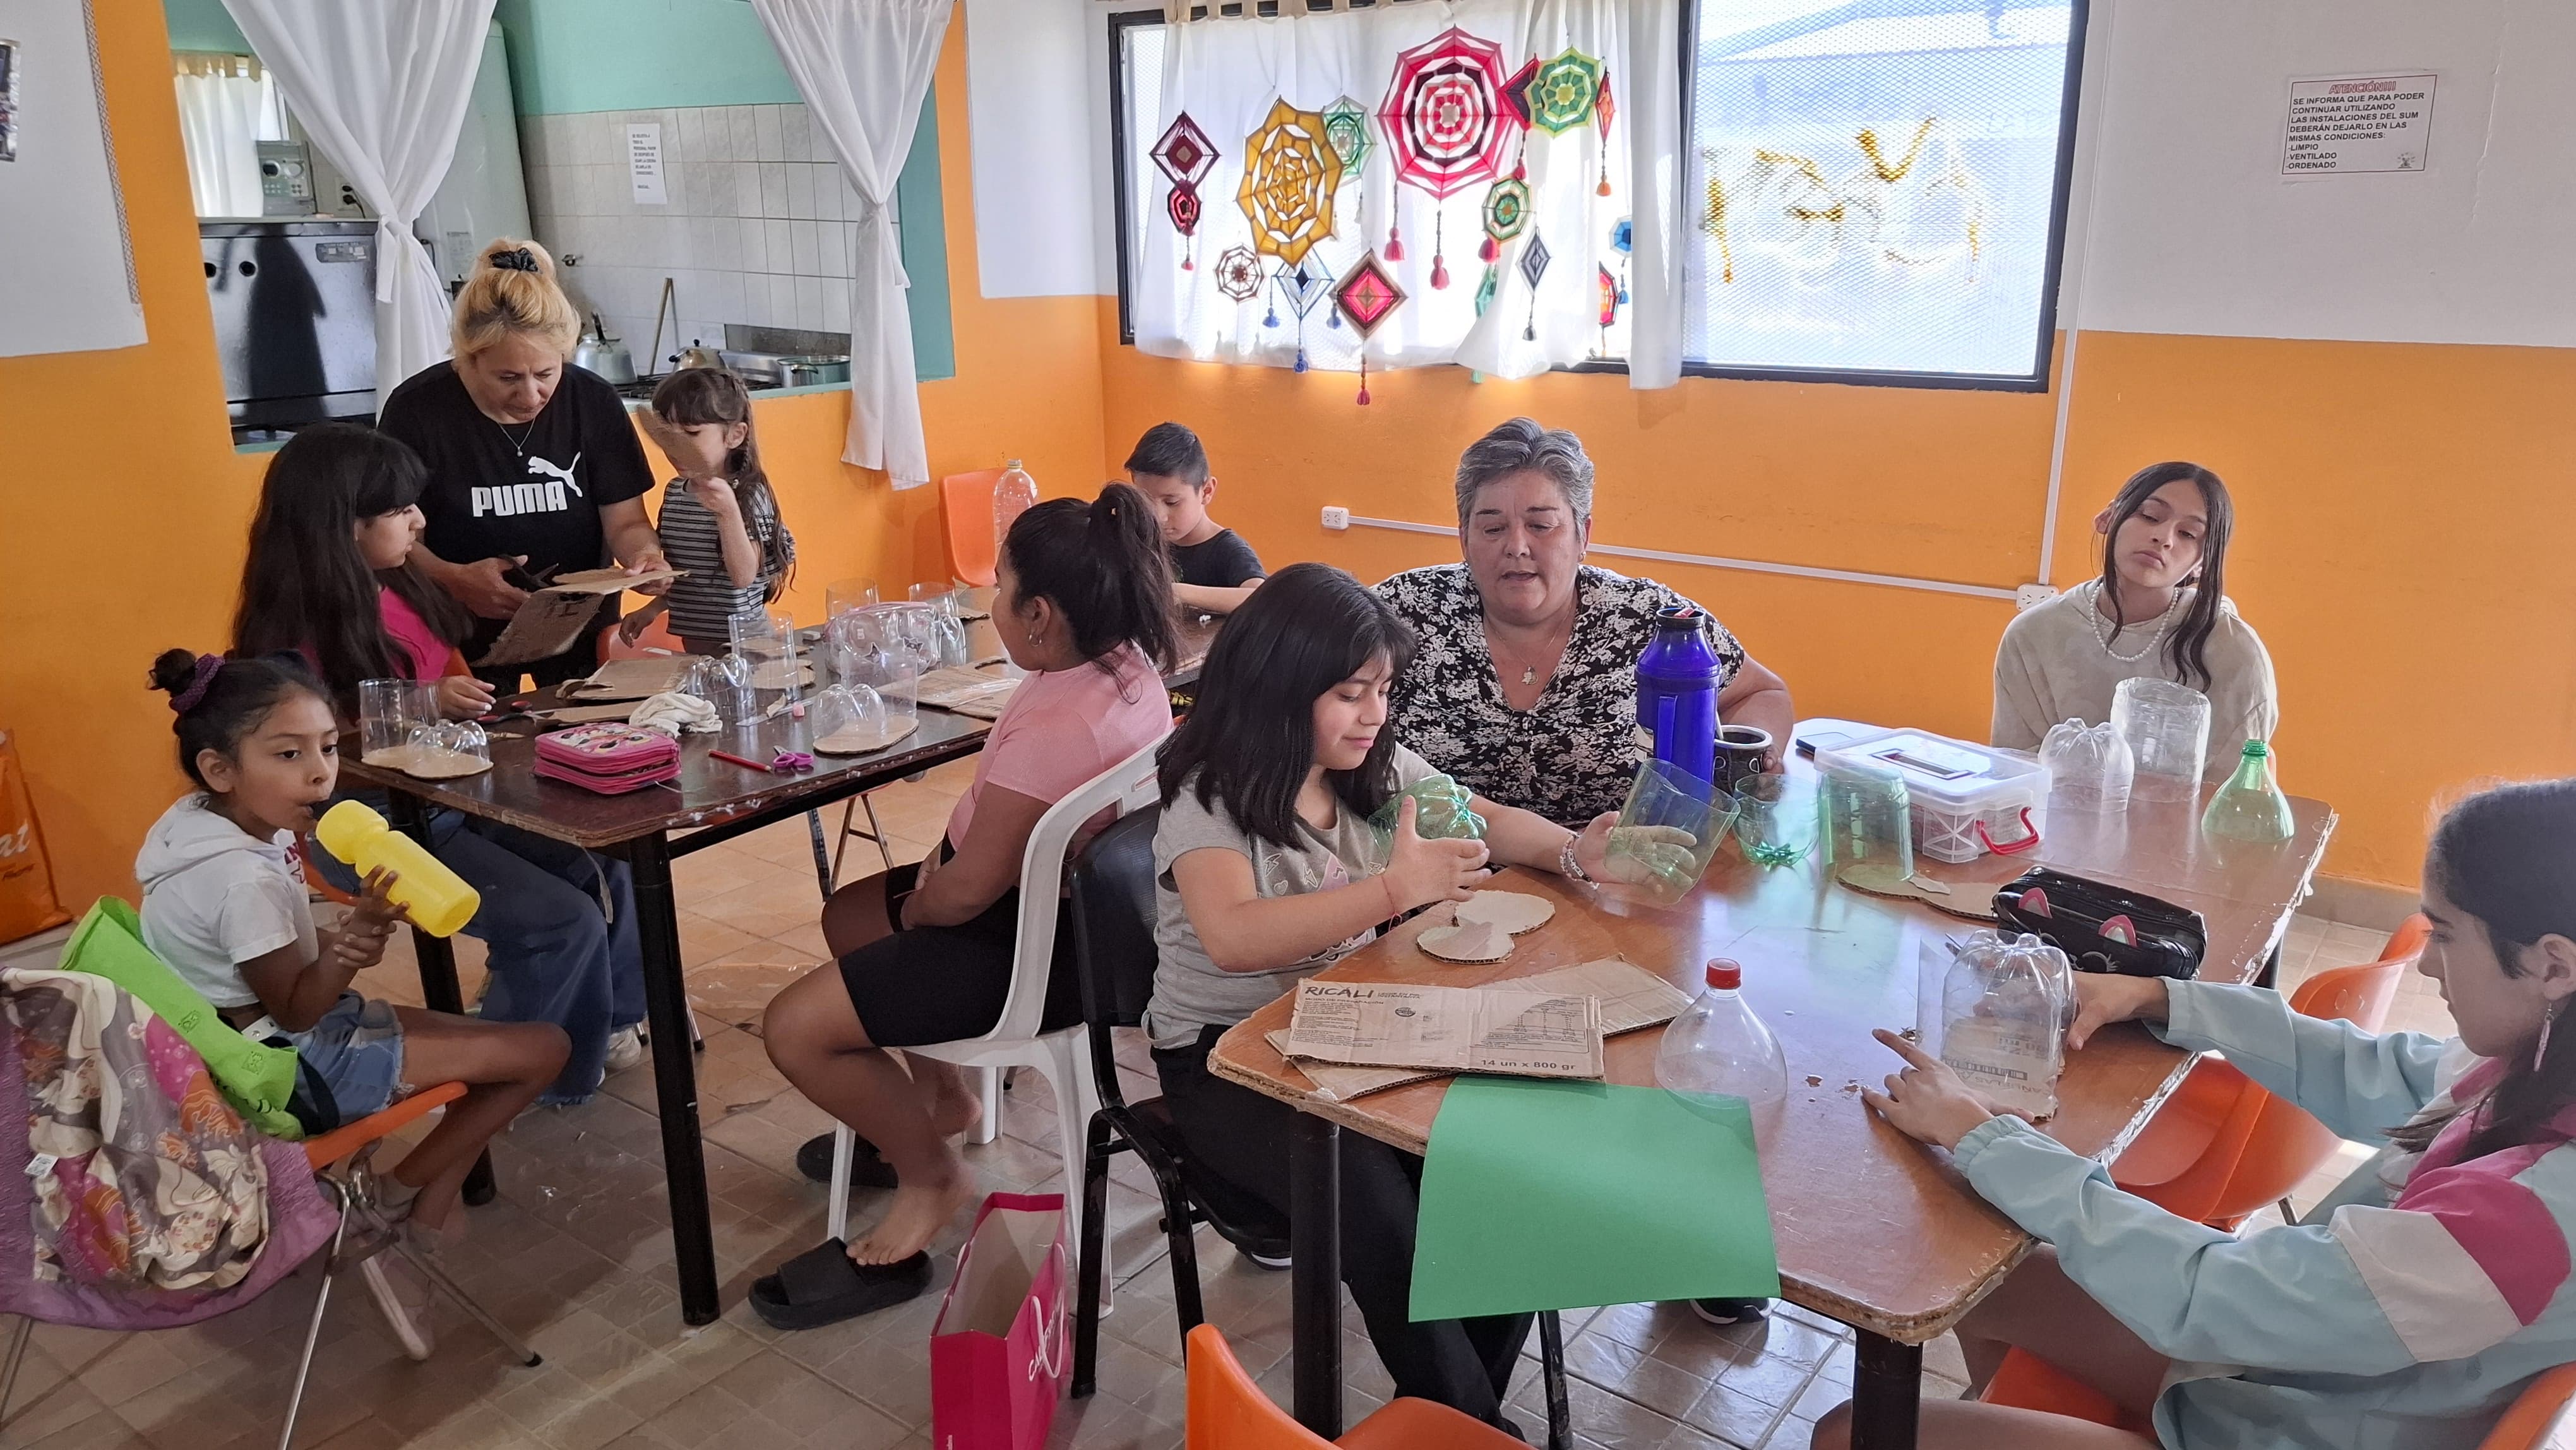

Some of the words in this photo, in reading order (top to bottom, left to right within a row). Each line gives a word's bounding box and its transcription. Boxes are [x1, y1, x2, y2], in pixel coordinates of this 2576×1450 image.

[2292, 106, 2341, 114] CONTINUAR
[2344, 104, 2395, 112] UTILIZANDO
[2310, 114, 2377, 123] INSTALACIONES
[2290, 123, 2330, 133] DEBERÁN
[2324, 132, 2386, 140] CONDICIONES:
[472, 481, 568, 517] PUMA
[1304, 986, 1374, 998] RICÁLI
